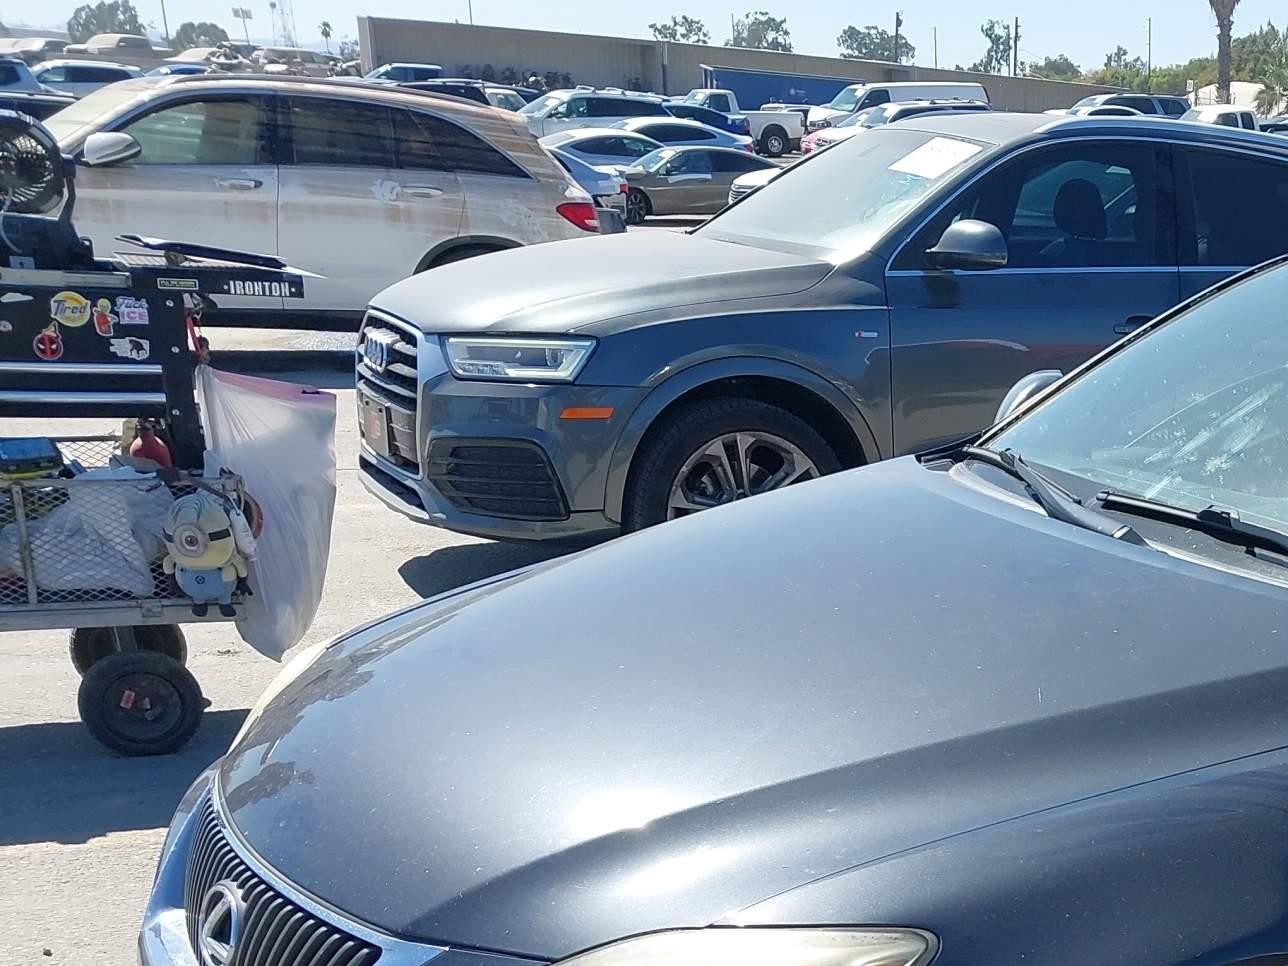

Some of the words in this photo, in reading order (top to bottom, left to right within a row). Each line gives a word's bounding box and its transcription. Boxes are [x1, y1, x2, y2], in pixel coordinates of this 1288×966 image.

[229, 280, 290, 297] IRONTON
[53, 298, 89, 317] Tired
[116, 296, 149, 310] Fuck
[121, 310, 148, 321] ICE
